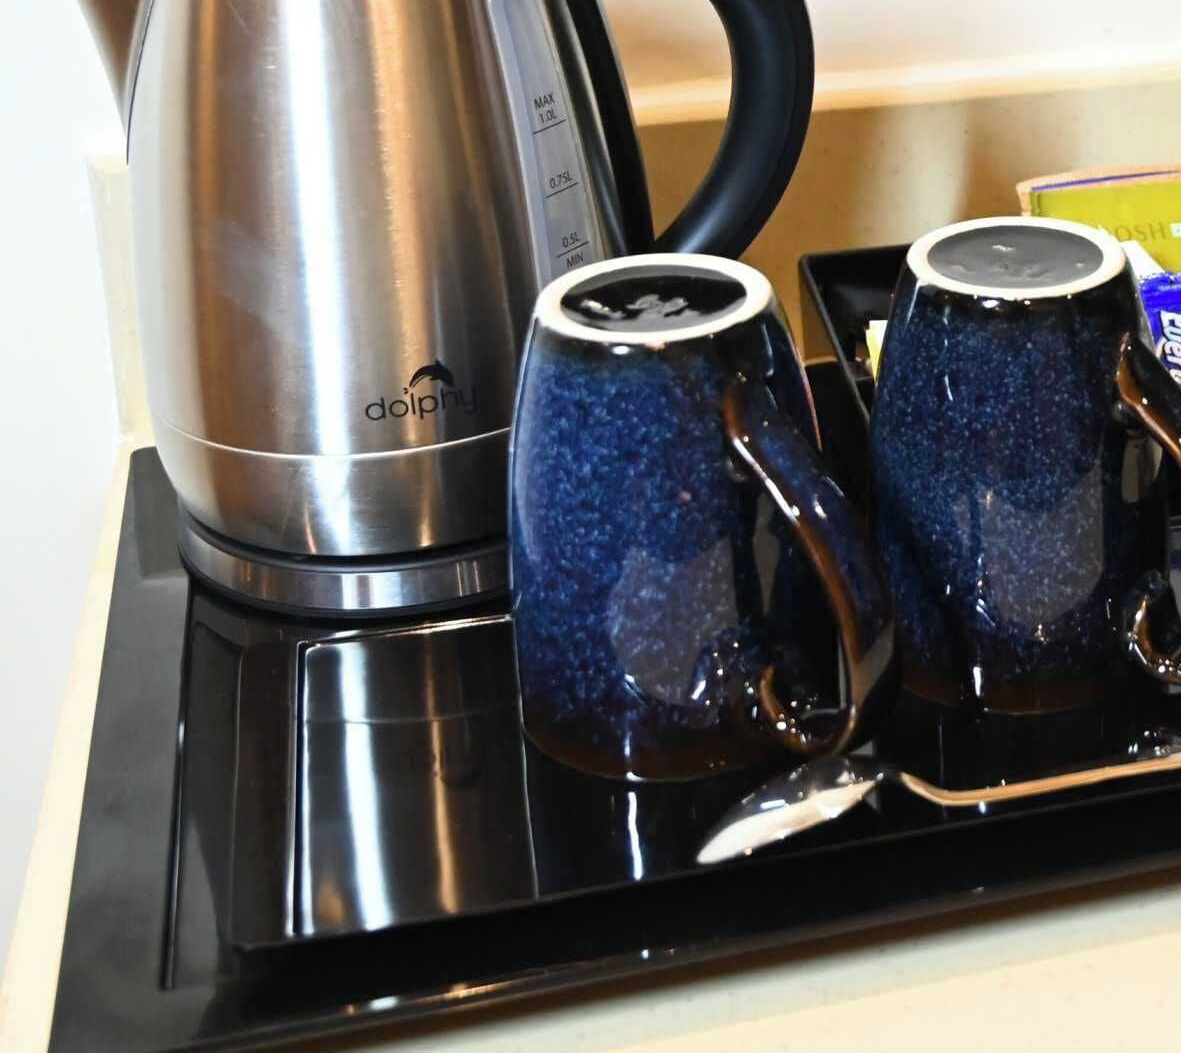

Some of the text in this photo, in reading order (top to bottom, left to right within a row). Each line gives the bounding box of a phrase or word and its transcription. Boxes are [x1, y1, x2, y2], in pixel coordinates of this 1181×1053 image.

[533, 93, 556, 110] MAX
[538, 108, 557, 124] 1.0L
[549, 172, 574, 189] 0.75L
[562, 231, 581, 247] 0.5L
[566, 252, 584, 268] MIN
[365, 387, 479, 421] dolphy
